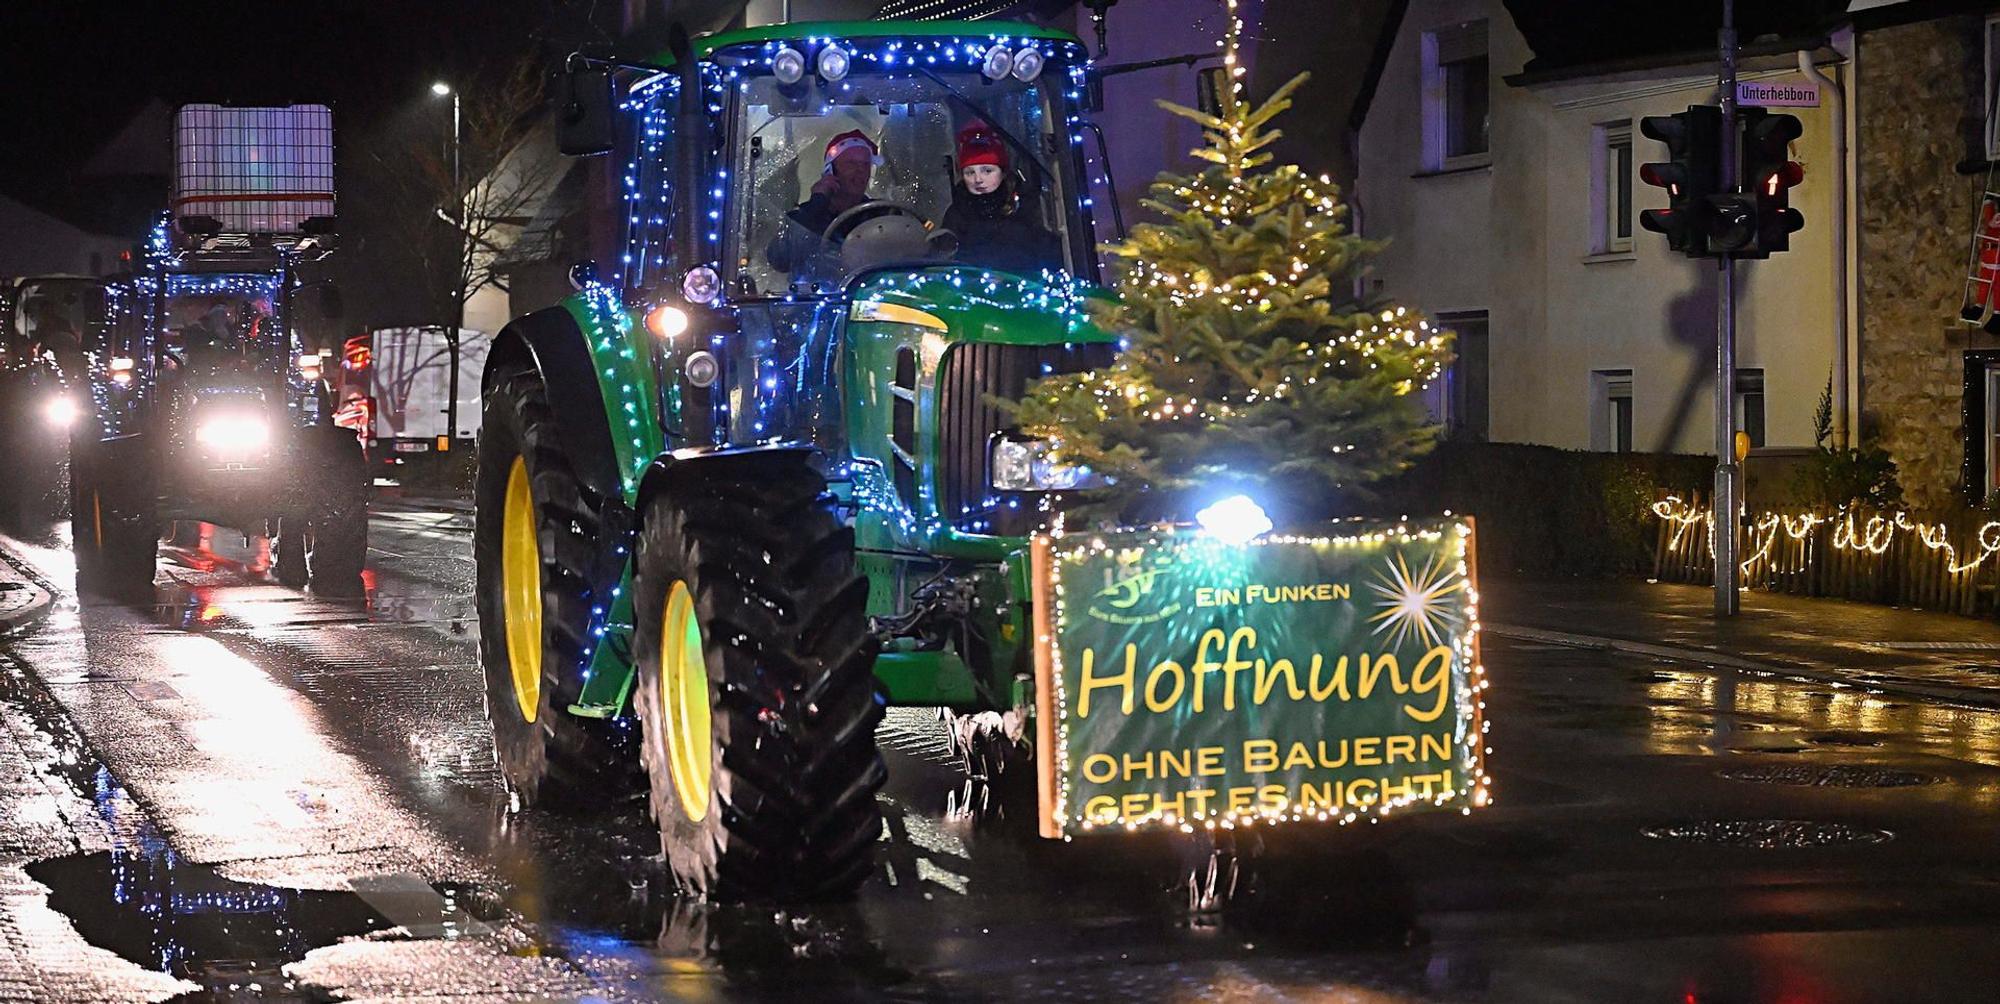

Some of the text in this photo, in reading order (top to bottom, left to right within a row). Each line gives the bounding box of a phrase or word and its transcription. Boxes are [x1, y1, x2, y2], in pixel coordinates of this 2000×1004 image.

[1742, 85, 1815, 101] Unterhebborn
[1195, 583, 1350, 607] EIN FUNKEN
[1077, 626, 1454, 722] Hoffnung
[1082, 732, 1453, 784] OHNE BAUERN
[1084, 768, 1454, 826] GEHT ES NICHT!
